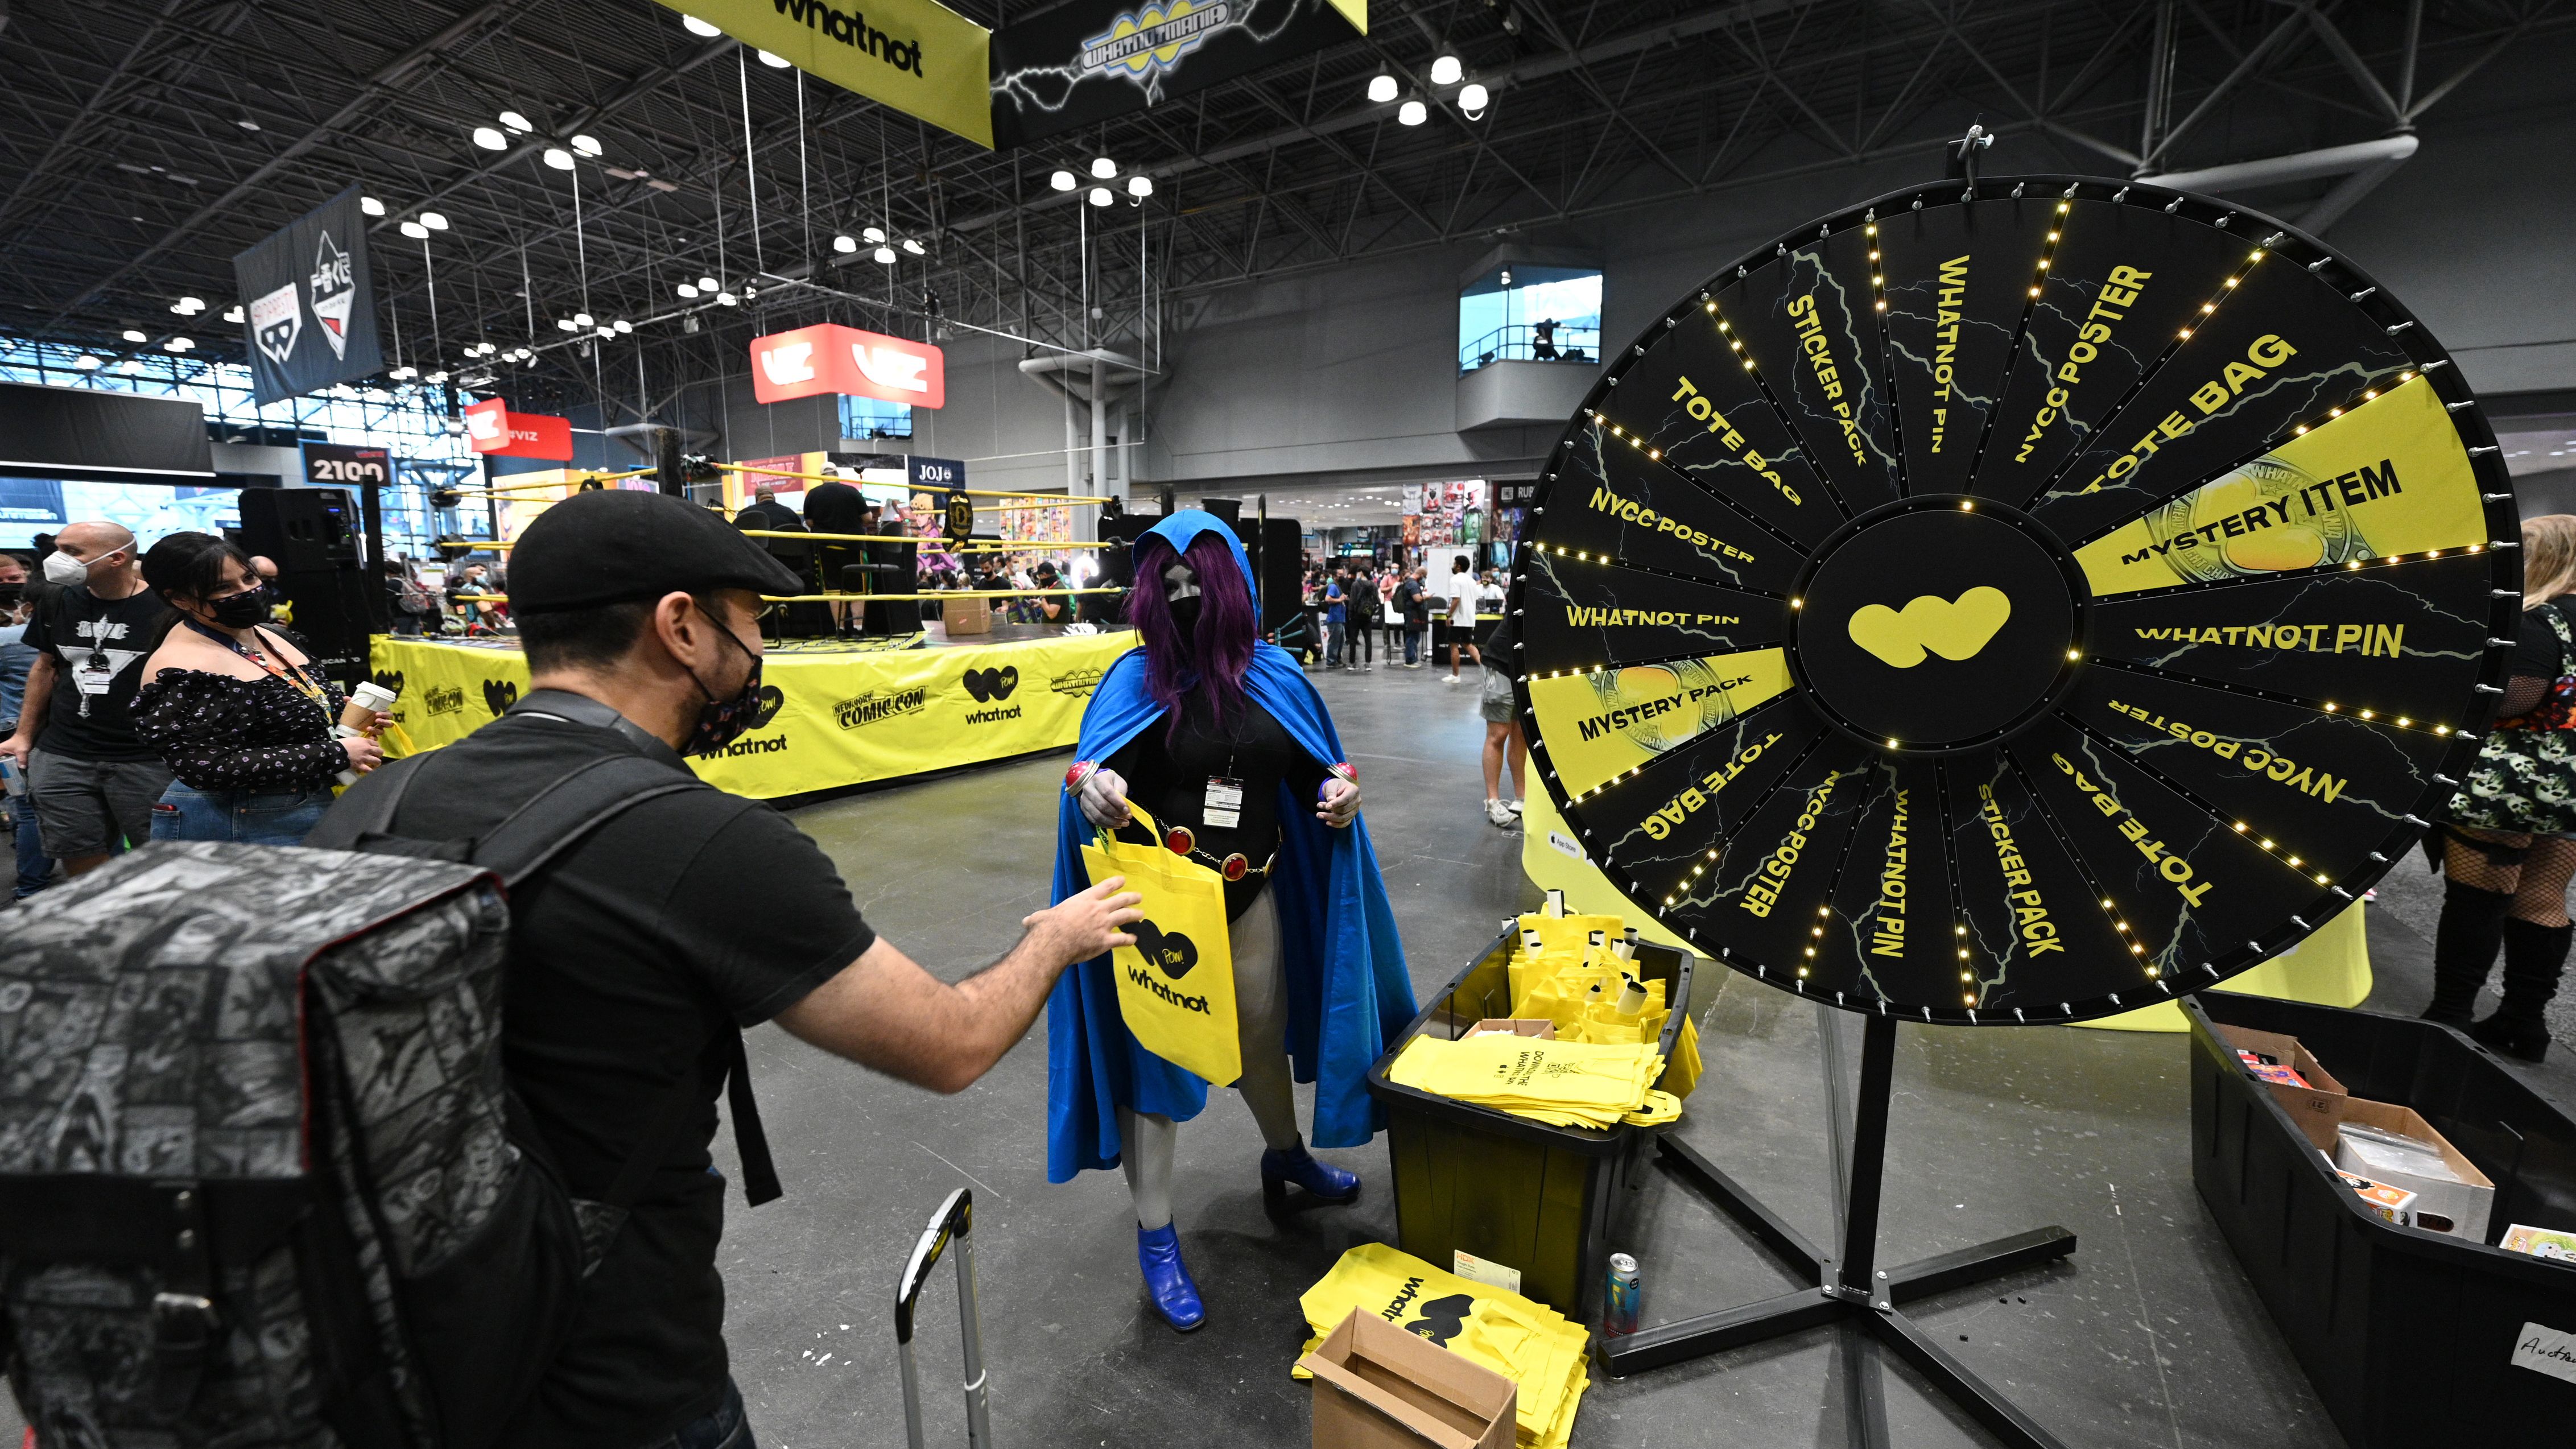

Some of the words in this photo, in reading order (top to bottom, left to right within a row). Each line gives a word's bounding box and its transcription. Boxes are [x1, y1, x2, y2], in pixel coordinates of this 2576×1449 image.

[774, 0, 923, 78] whatnot
[1089, 6, 1225, 65] WHATNOTMANIA
[1934, 255, 1970, 402] WHATNOT
[1787, 295, 1843, 401] STICKER
[1832, 402, 1867, 468] PACK
[2014, 387, 2069, 463] NYCC
[2058, 265, 2153, 384] POSTER
[1671, 375, 1745, 452] TOTE
[1743, 449, 1802, 506] BAG
[1931, 408, 1947, 453] PIN
[2079, 410, 2194, 496] TOTE
[2189, 334, 2298, 415] BAG
[313, 459, 385, 482] 2100
[1589, 487, 1656, 527] NYCC
[1657, 517, 1755, 564] POSTER
[2121, 495, 2291, 565] MYSTERY
[2300, 458, 2402, 517] ITEM
[1566, 605, 1691, 626] WHATNOT
[1697, 614, 1740, 625] PIN
[2135, 625, 2329, 653] WHATNOT
[2334, 624, 2404, 659] PIN
[834, 700, 853, 715] NEW
[853, 691, 873, 708] YORK
[840, 697, 893, 728] COMIC
[894, 688, 924, 712] CON
[965, 705, 1022, 725] whatnot
[1578, 693, 1683, 742] MYSTERY
[1689, 674, 1753, 703] PACK
[2108, 699, 2241, 760] POSTER
[1703, 733, 1783, 794] TOTE
[2051, 753, 2122, 818] BAG
[2243, 749, 2348, 804] NYCC
[1639, 786, 1707, 840] BAG
[1797, 769, 1841, 831] NYCC
[1557, 838, 1565, 848] App
[1565, 842, 1576, 853] Store
[1739, 831, 1807, 918] POSTER
[1879, 789, 1909, 915] WHATNOT
[1978, 784, 2032, 888] STICKER
[2011, 889, 2065, 959] PACK
[2117, 818, 2213, 909] TOTE
[1871, 916, 1905, 959] PIN
[1127, 964, 1211, 1015] whatnot
[1456, 1252, 1475, 1265] HDX
[1381, 1277, 1425, 1323] whatn
